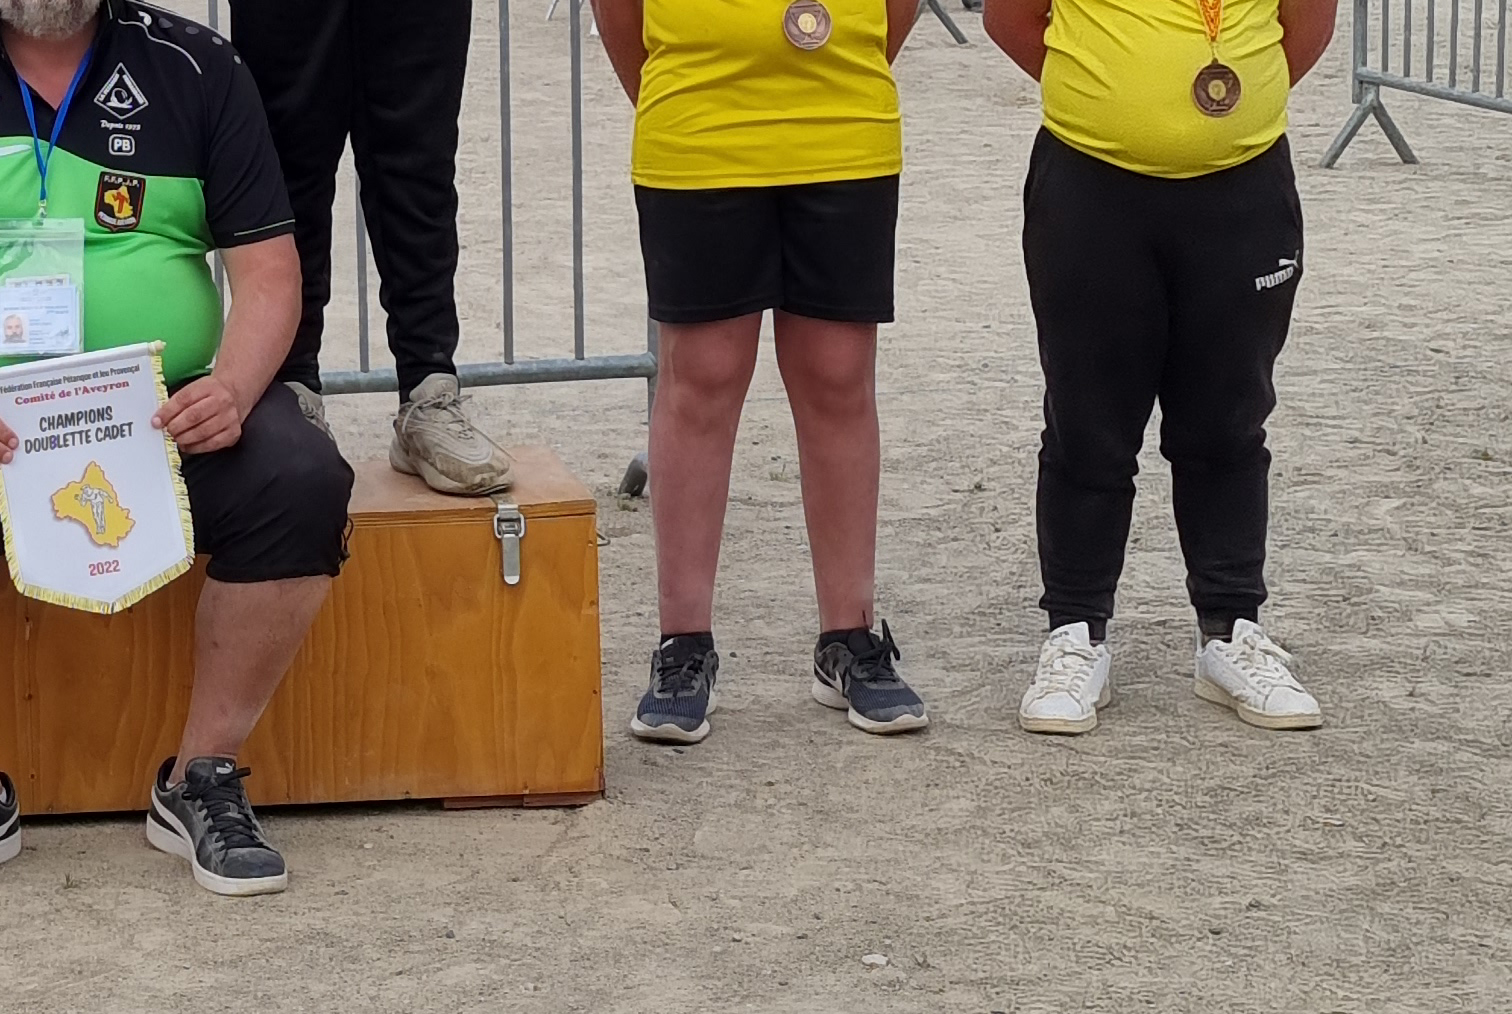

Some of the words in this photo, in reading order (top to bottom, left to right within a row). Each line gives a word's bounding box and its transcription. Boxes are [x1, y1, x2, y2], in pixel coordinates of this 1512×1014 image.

[113, 138, 132, 152] PB
[0, 383, 33, 394] Fédération
[33, 377, 63, 388] Française
[62, 373, 92, 383] Pétanque
[92, 371, 99, 379] et
[99, 369, 110, 378] Jeu
[110, 364, 140, 376] Provençal
[14, 391, 56, 405] Comité
[58, 389, 72, 399] de
[74, 381, 130, 396] l'Aveyron
[39, 405, 114, 433] CHAMPIONS
[24, 428, 92, 454] DOUBLETTE
[94, 421, 134, 443] CADET
[88, 558, 122, 577] 2022
